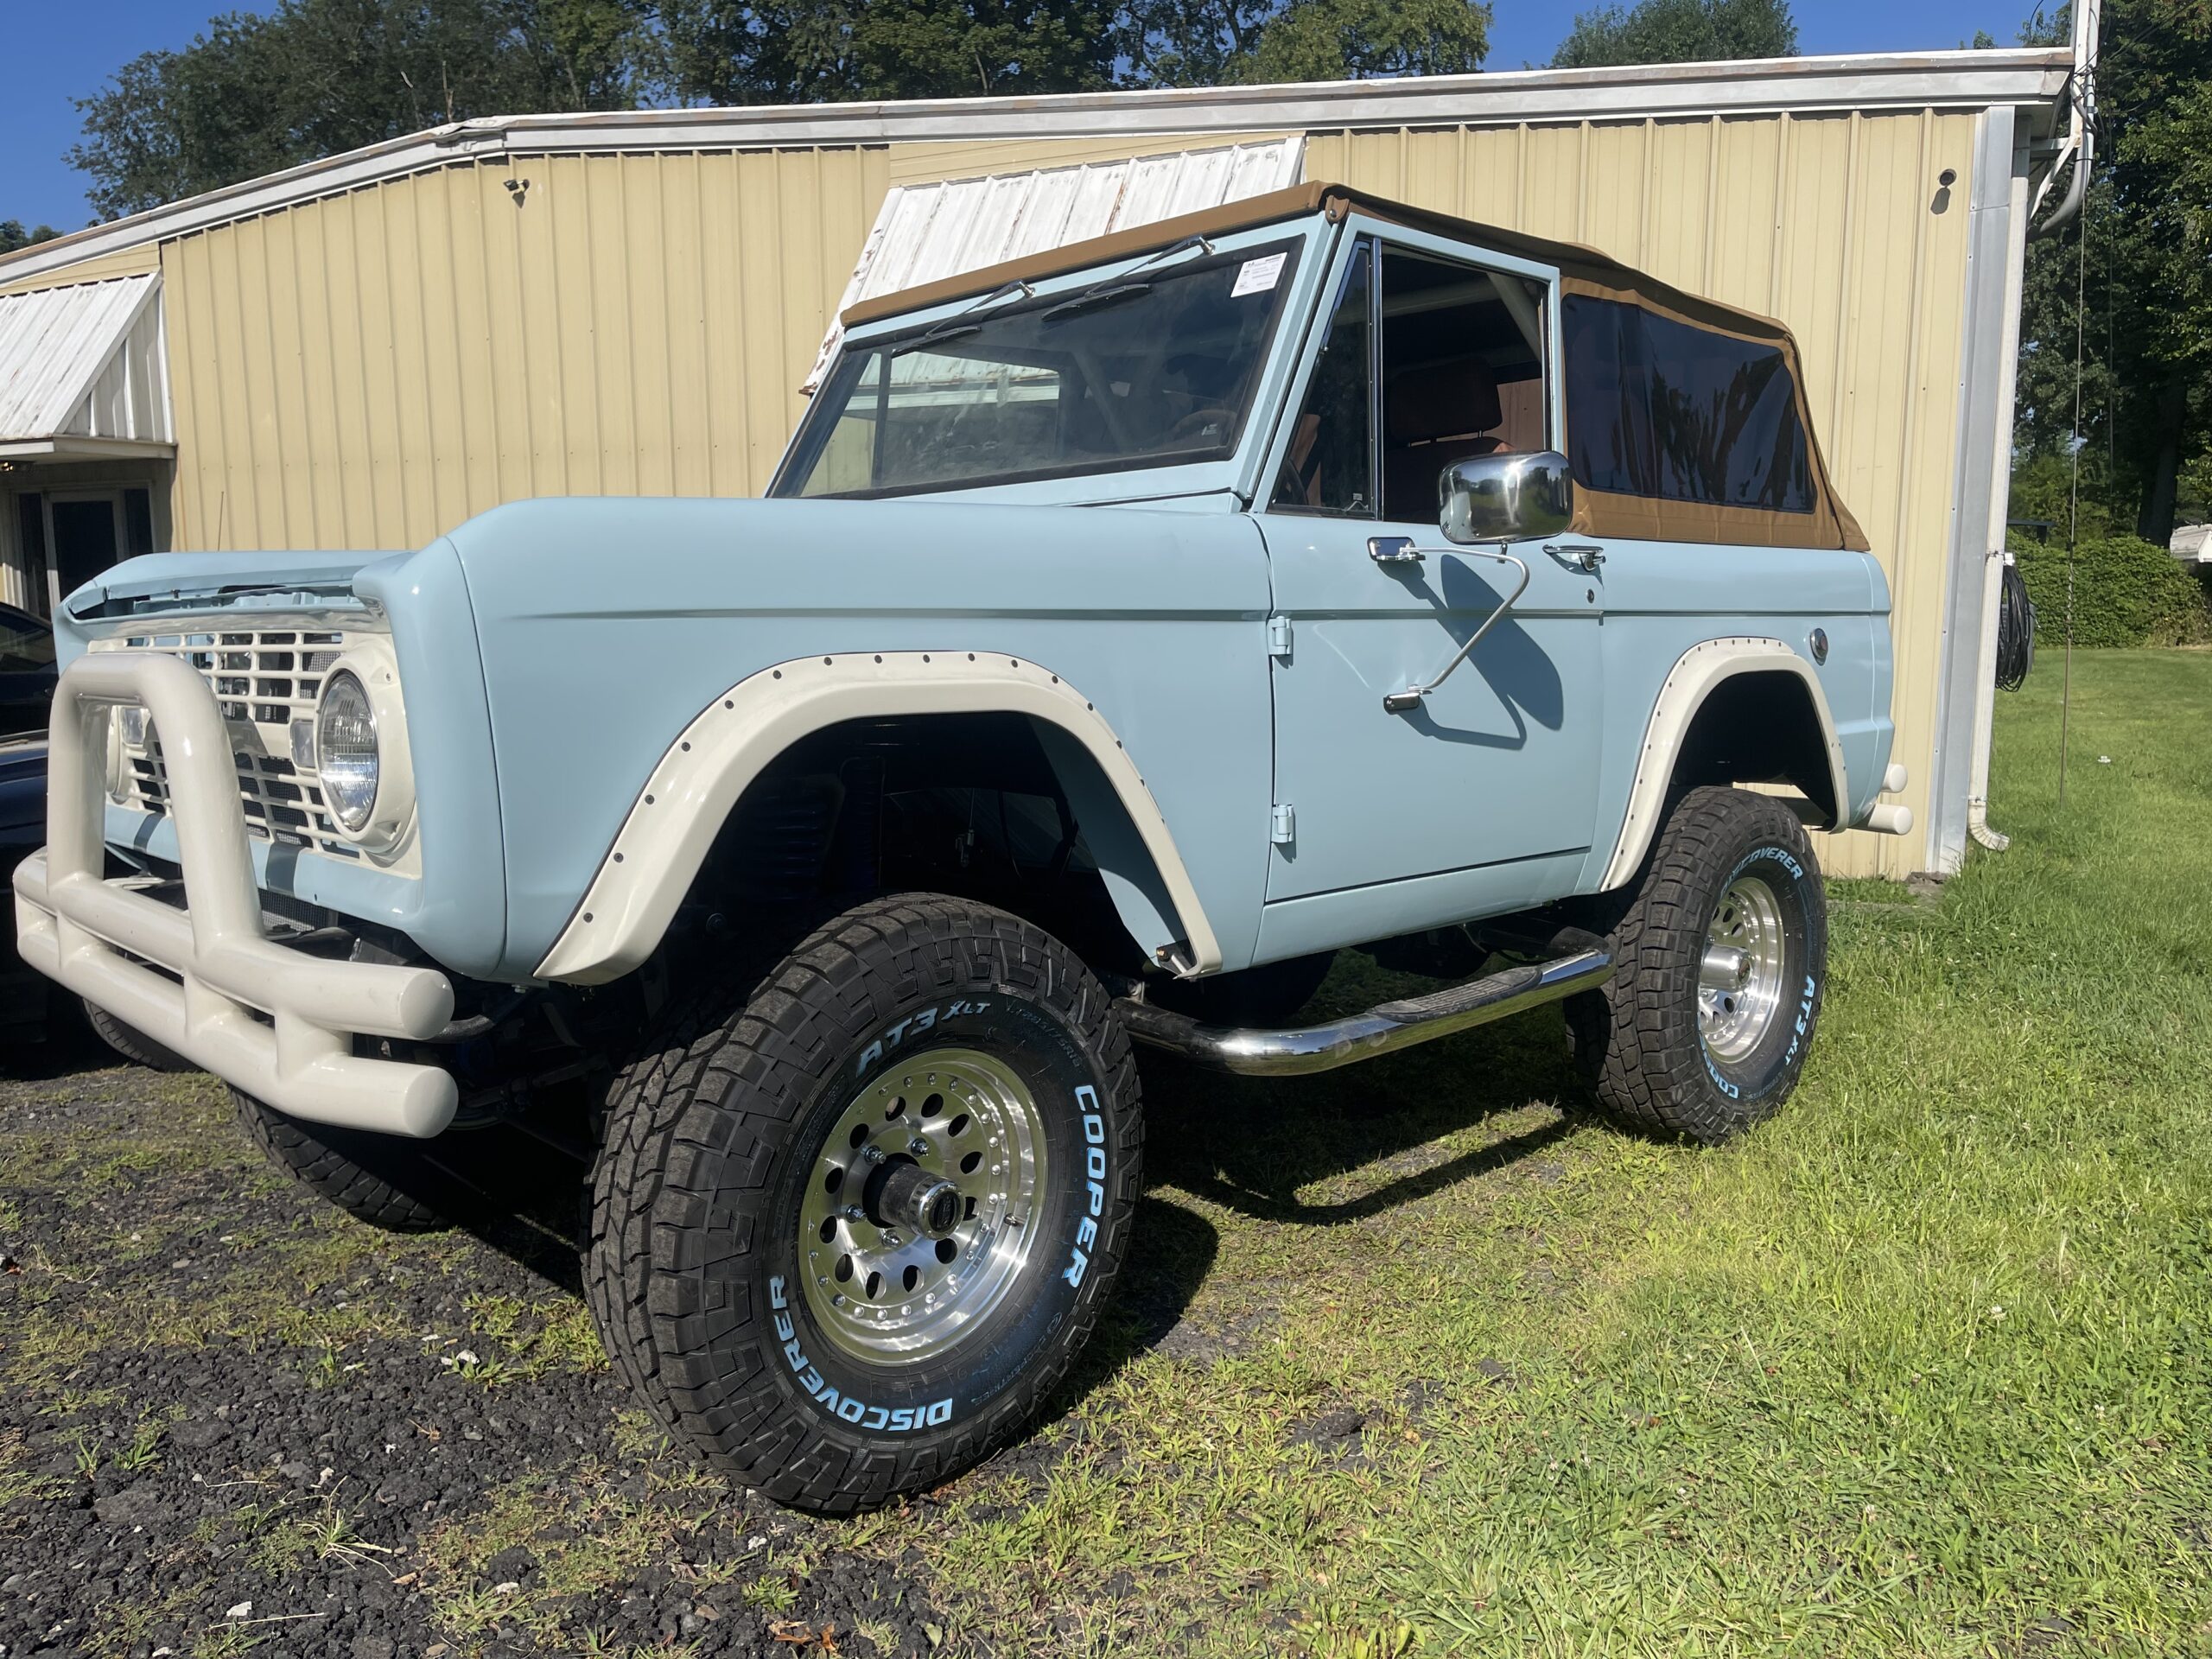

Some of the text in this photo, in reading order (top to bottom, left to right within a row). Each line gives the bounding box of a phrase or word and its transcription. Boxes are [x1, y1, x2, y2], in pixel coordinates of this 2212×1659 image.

[855, 1000, 992, 1078] AT3 XLT
[1795, 975, 1815, 1036] AT3
[1697, 1009, 1739, 1099] COOP
[1785, 1034, 1799, 1066] XLT
[1061, 1084, 1106, 1288] COOPER
[769, 1274, 953, 1431] DISCOVERER
